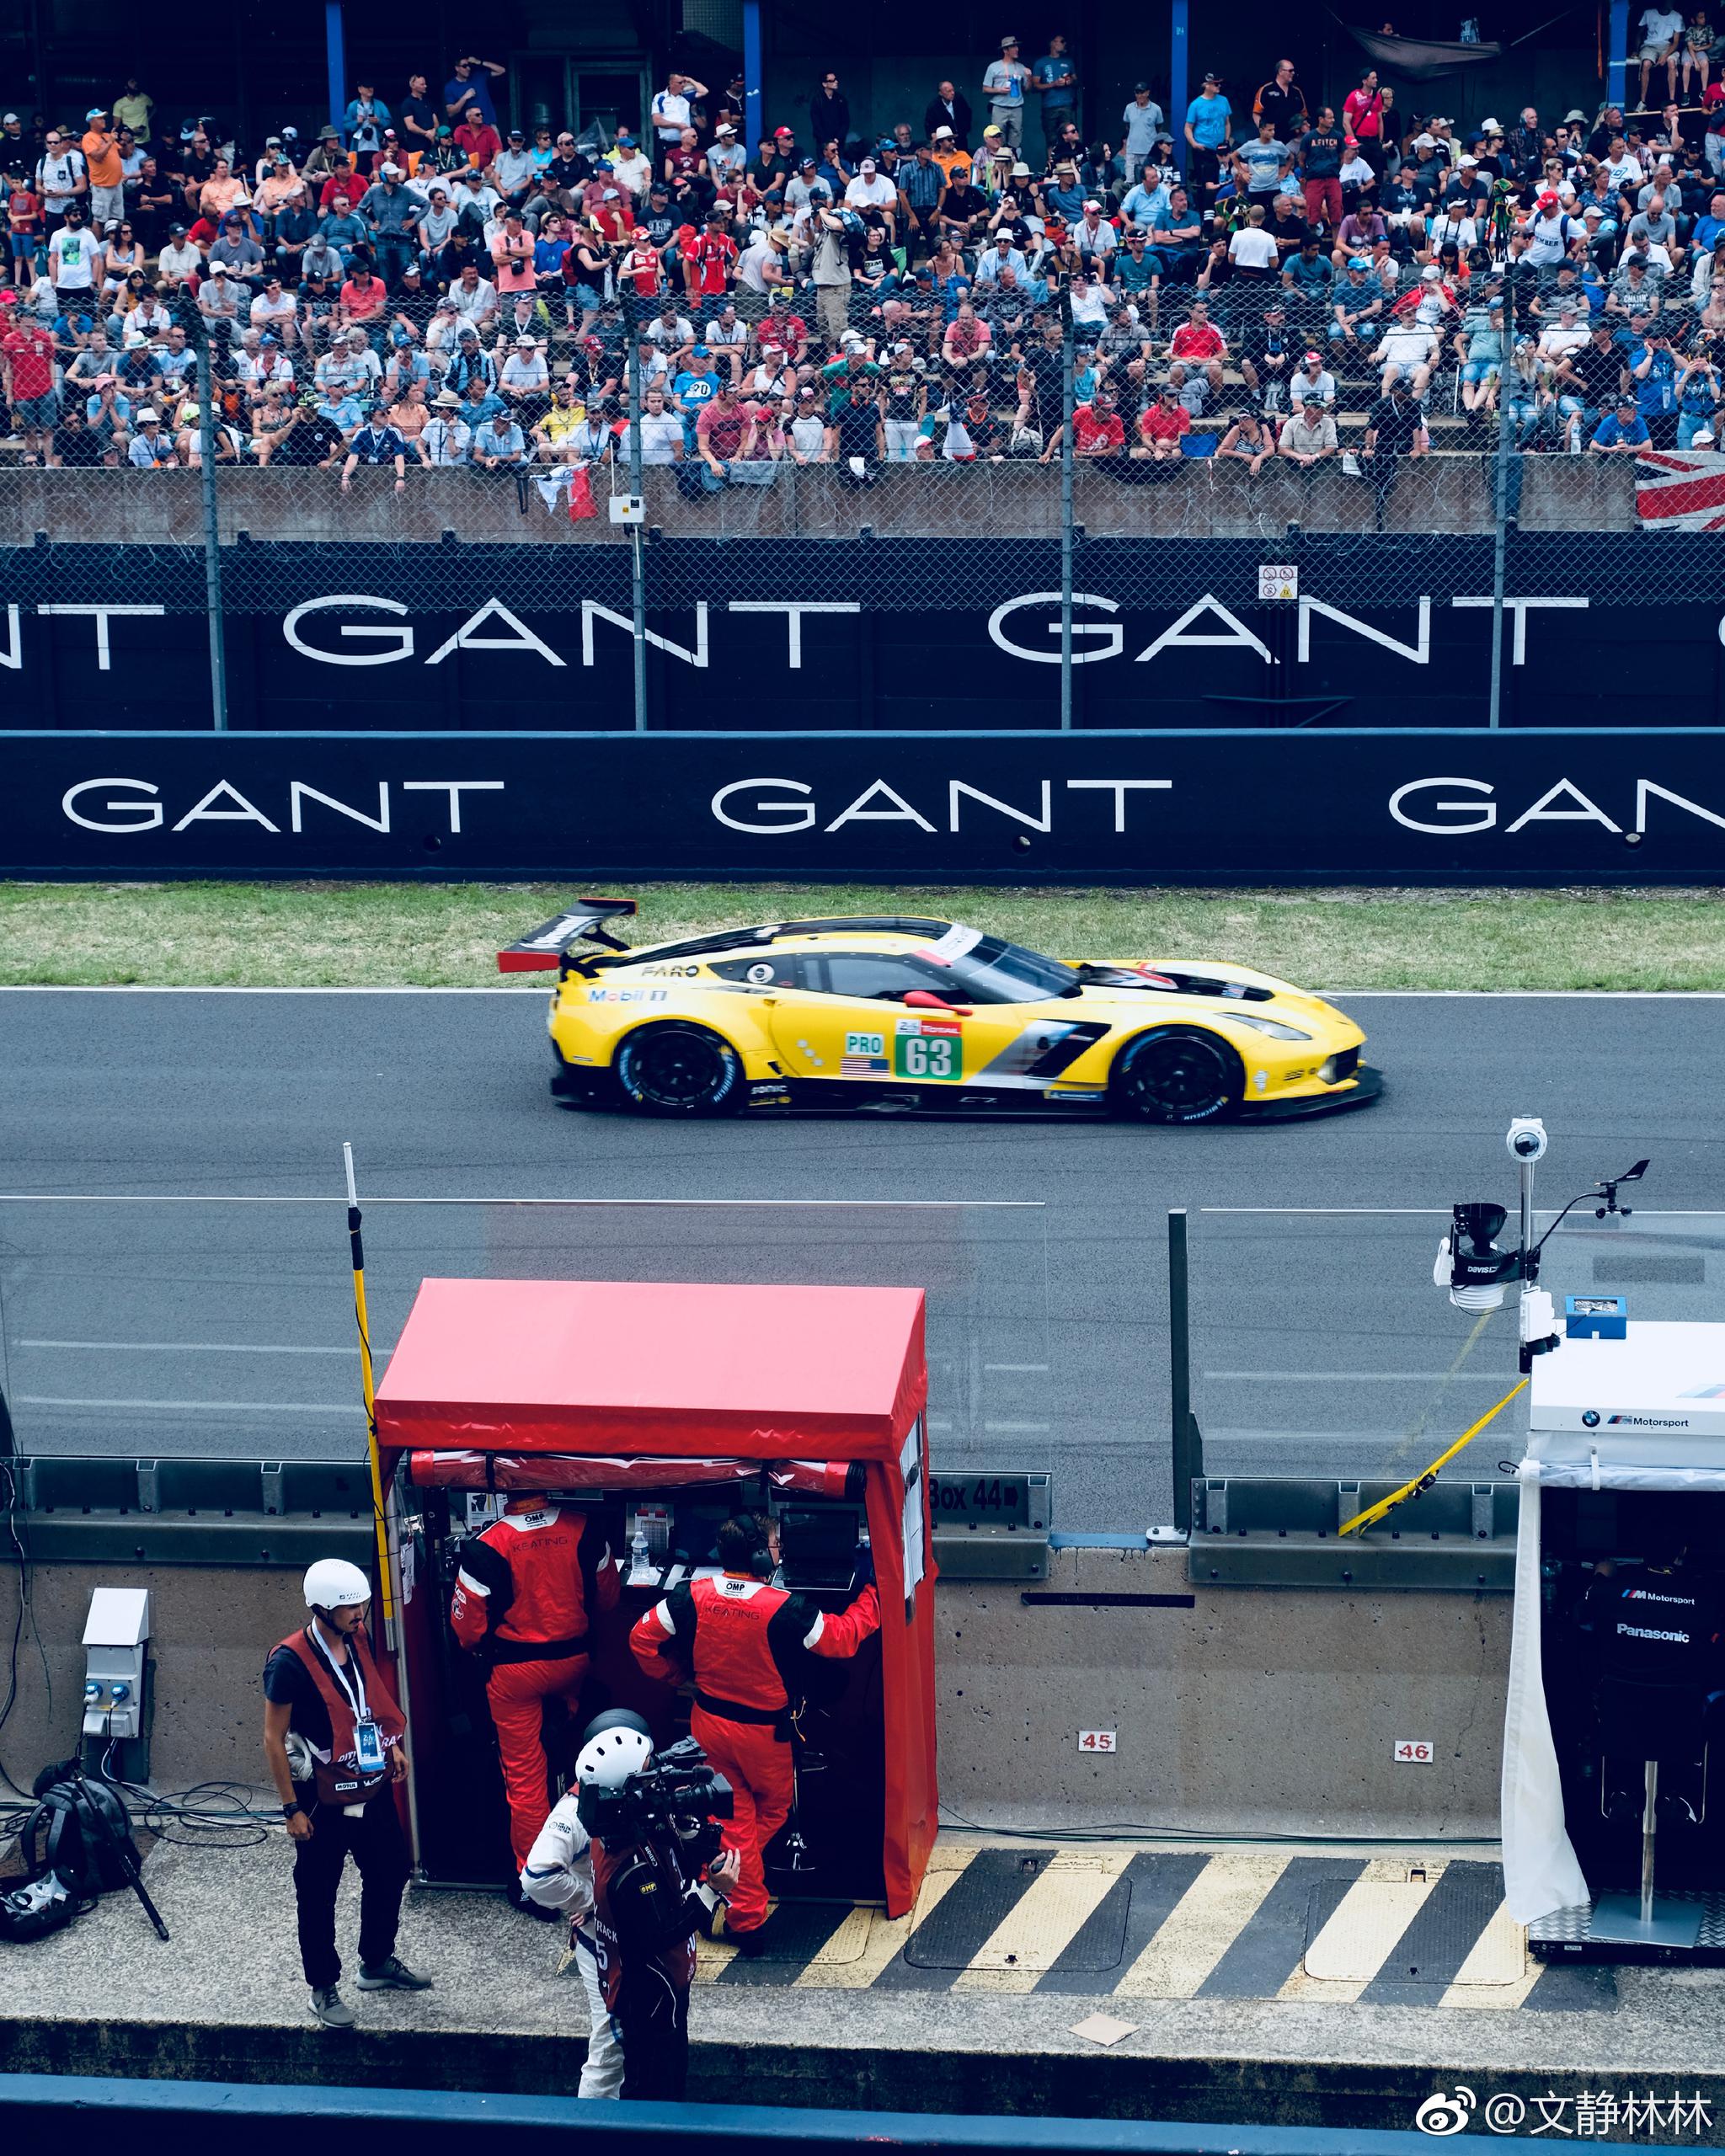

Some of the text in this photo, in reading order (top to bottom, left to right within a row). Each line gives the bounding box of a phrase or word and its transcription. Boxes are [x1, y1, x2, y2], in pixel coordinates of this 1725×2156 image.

[282, 594, 861, 669] GANT
[988, 592, 1589, 665] GANT
[61, 777, 505, 833] GANT
[711, 777, 1172, 834] GANT
[641, 965, 700, 978] FARO
[588, 990, 645, 1001] Mobil
[848, 1035, 881, 1054] PRO
[905, 1038, 952, 1076] 63
[1633, 1417, 1690, 1428] Motorsport
[929, 1478, 1001, 1511] Box 44
[524, 1513, 545, 1523] OMP
[512, 1536, 568, 1553] KEATING
[725, 1582, 745, 1592] OMP
[1648, 1592, 1696, 1605] Motorsport
[705, 1607, 762, 1620] KEATING
[1616, 1623, 1690, 1643] Panasonic
[1083, 1733, 1111, 1749] 45
[1398, 1744, 1429, 1760] 46
